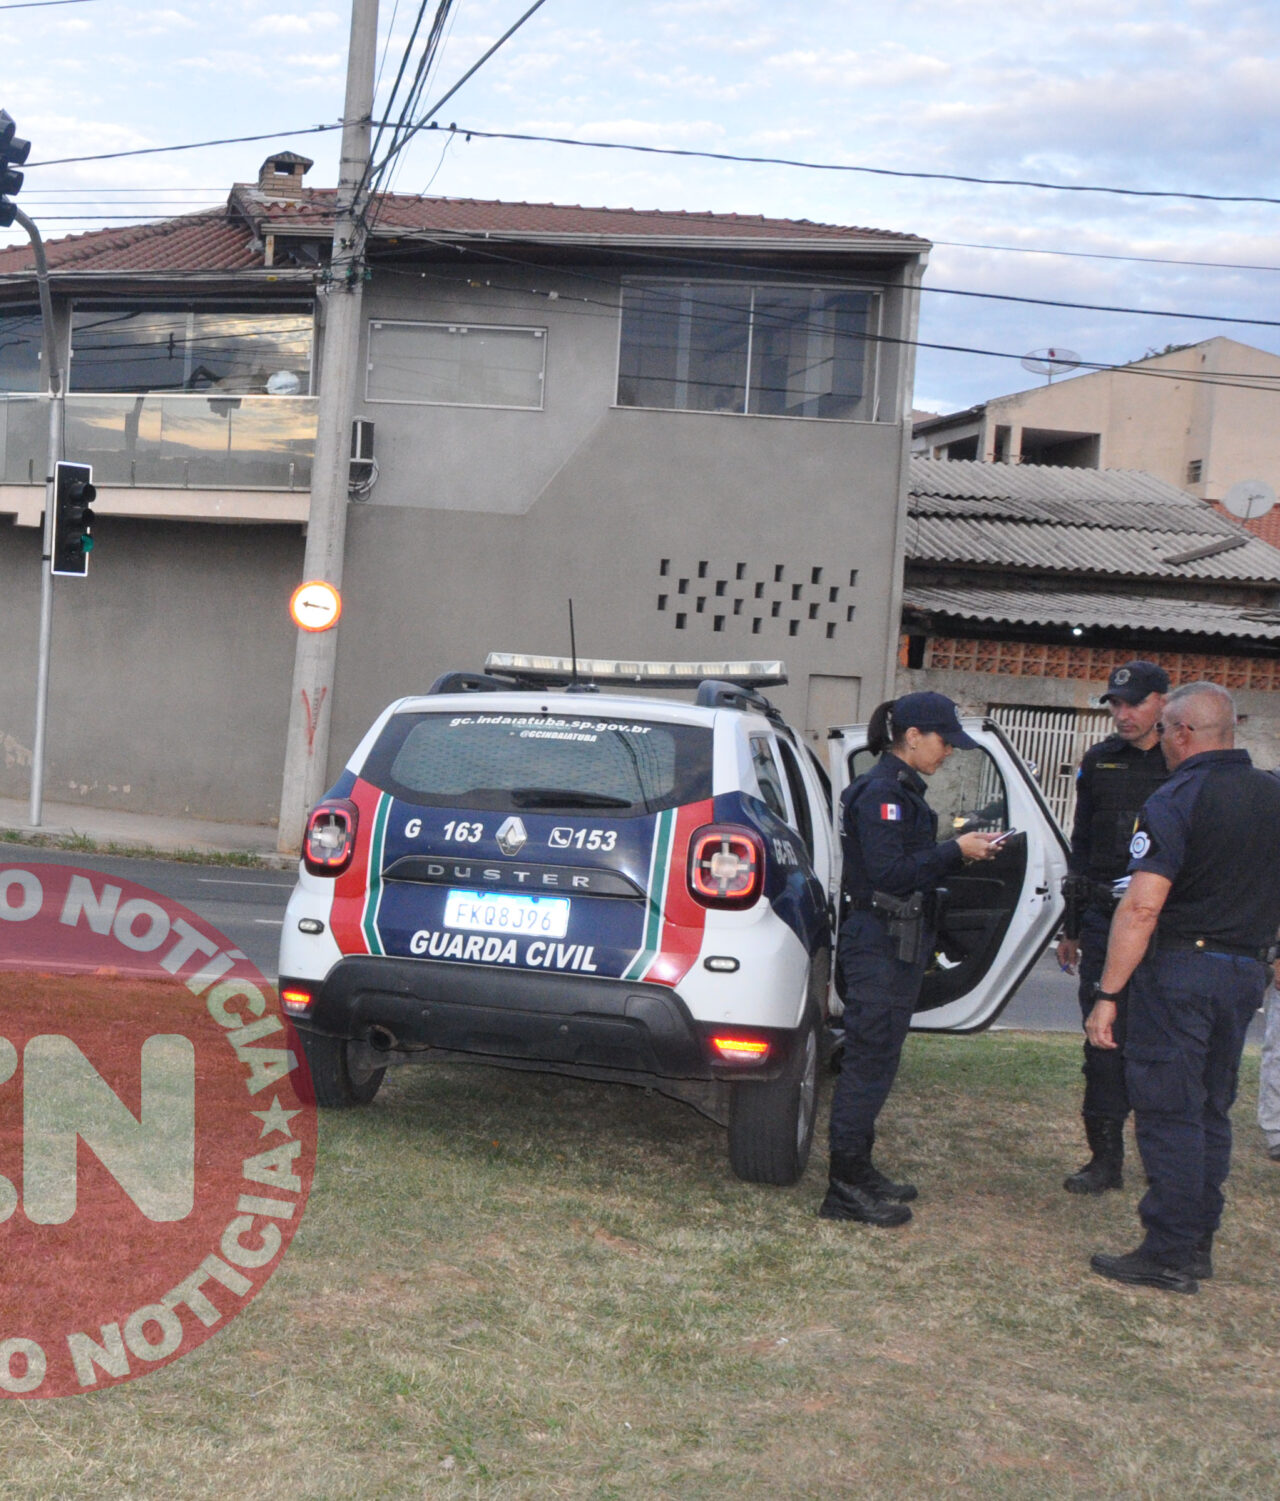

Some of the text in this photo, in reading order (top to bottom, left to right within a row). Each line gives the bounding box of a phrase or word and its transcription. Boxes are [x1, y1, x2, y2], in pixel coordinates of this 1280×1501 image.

[449, 715, 652, 734] gc.indaiatuba.sp.gov.br
[404, 818, 484, 843] G 163
[573, 828, 618, 851] 153
[427, 864, 590, 888] DUSTER
[456, 903, 552, 931] FKQ8J96
[409, 930, 598, 972] GUARDA CIVIL
